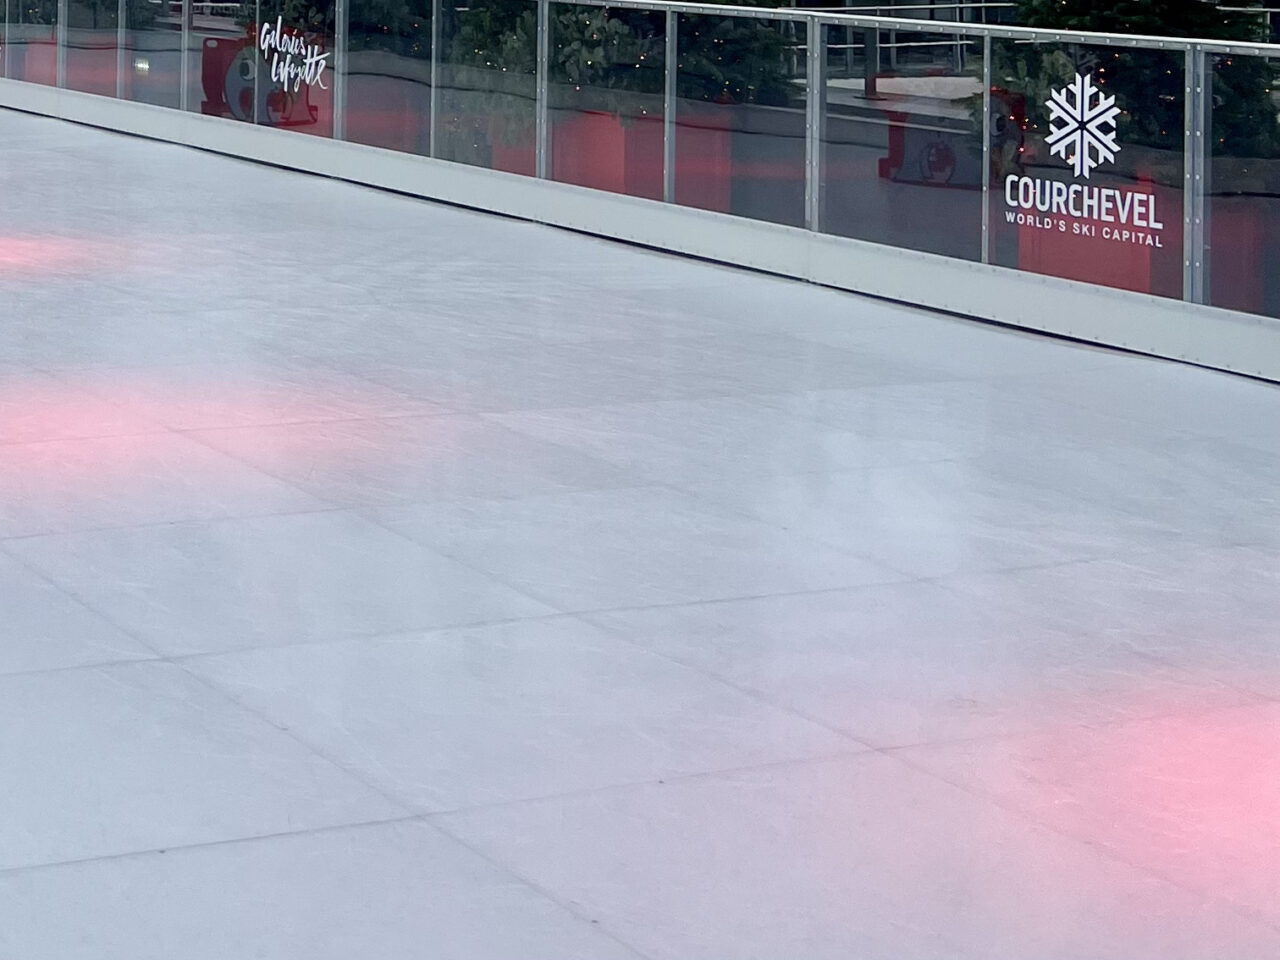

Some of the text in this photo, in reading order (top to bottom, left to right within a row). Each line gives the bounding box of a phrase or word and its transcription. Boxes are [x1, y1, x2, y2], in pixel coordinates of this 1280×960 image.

[260, 15, 306, 59] Galeries
[271, 45, 331, 92] Lafayette
[1004, 174, 1164, 230] COURCHEVEL
[1005, 211, 1164, 248] WORLD'S SKI CAPITAL
